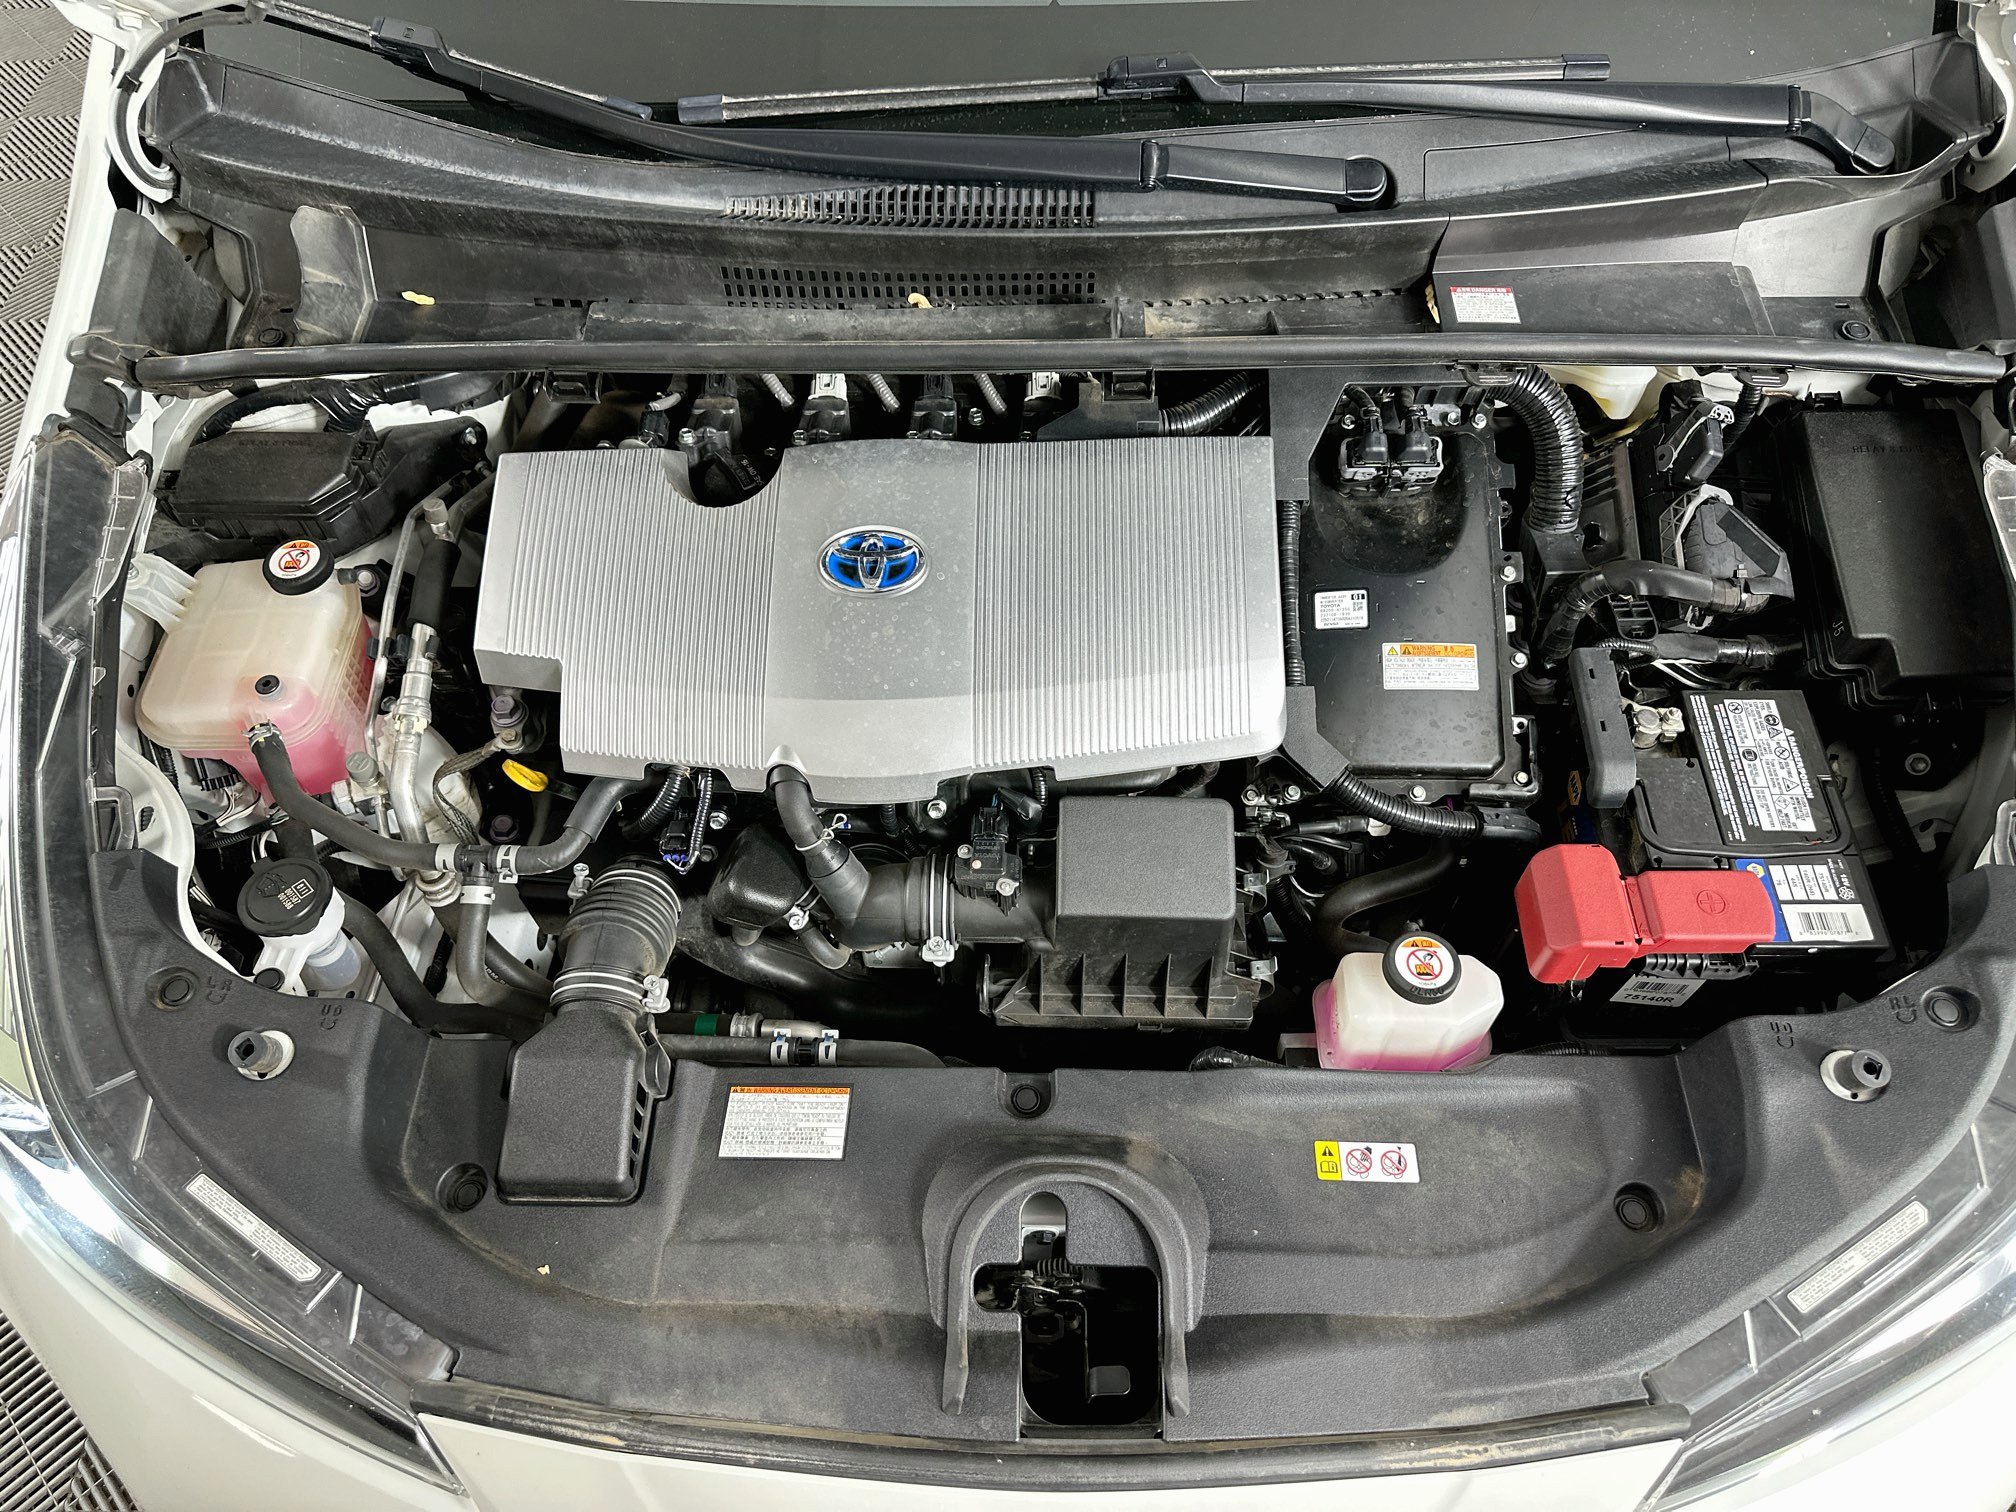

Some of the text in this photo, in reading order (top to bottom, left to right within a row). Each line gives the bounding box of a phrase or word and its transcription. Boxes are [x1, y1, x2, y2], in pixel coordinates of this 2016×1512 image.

[1786, 736, 1814, 798] DANGER/POISON
[1817, 872, 1829, 892] 75140R
[1839, 874, 1850, 886] 12V
[1624, 994, 1674, 1002] 75140R
